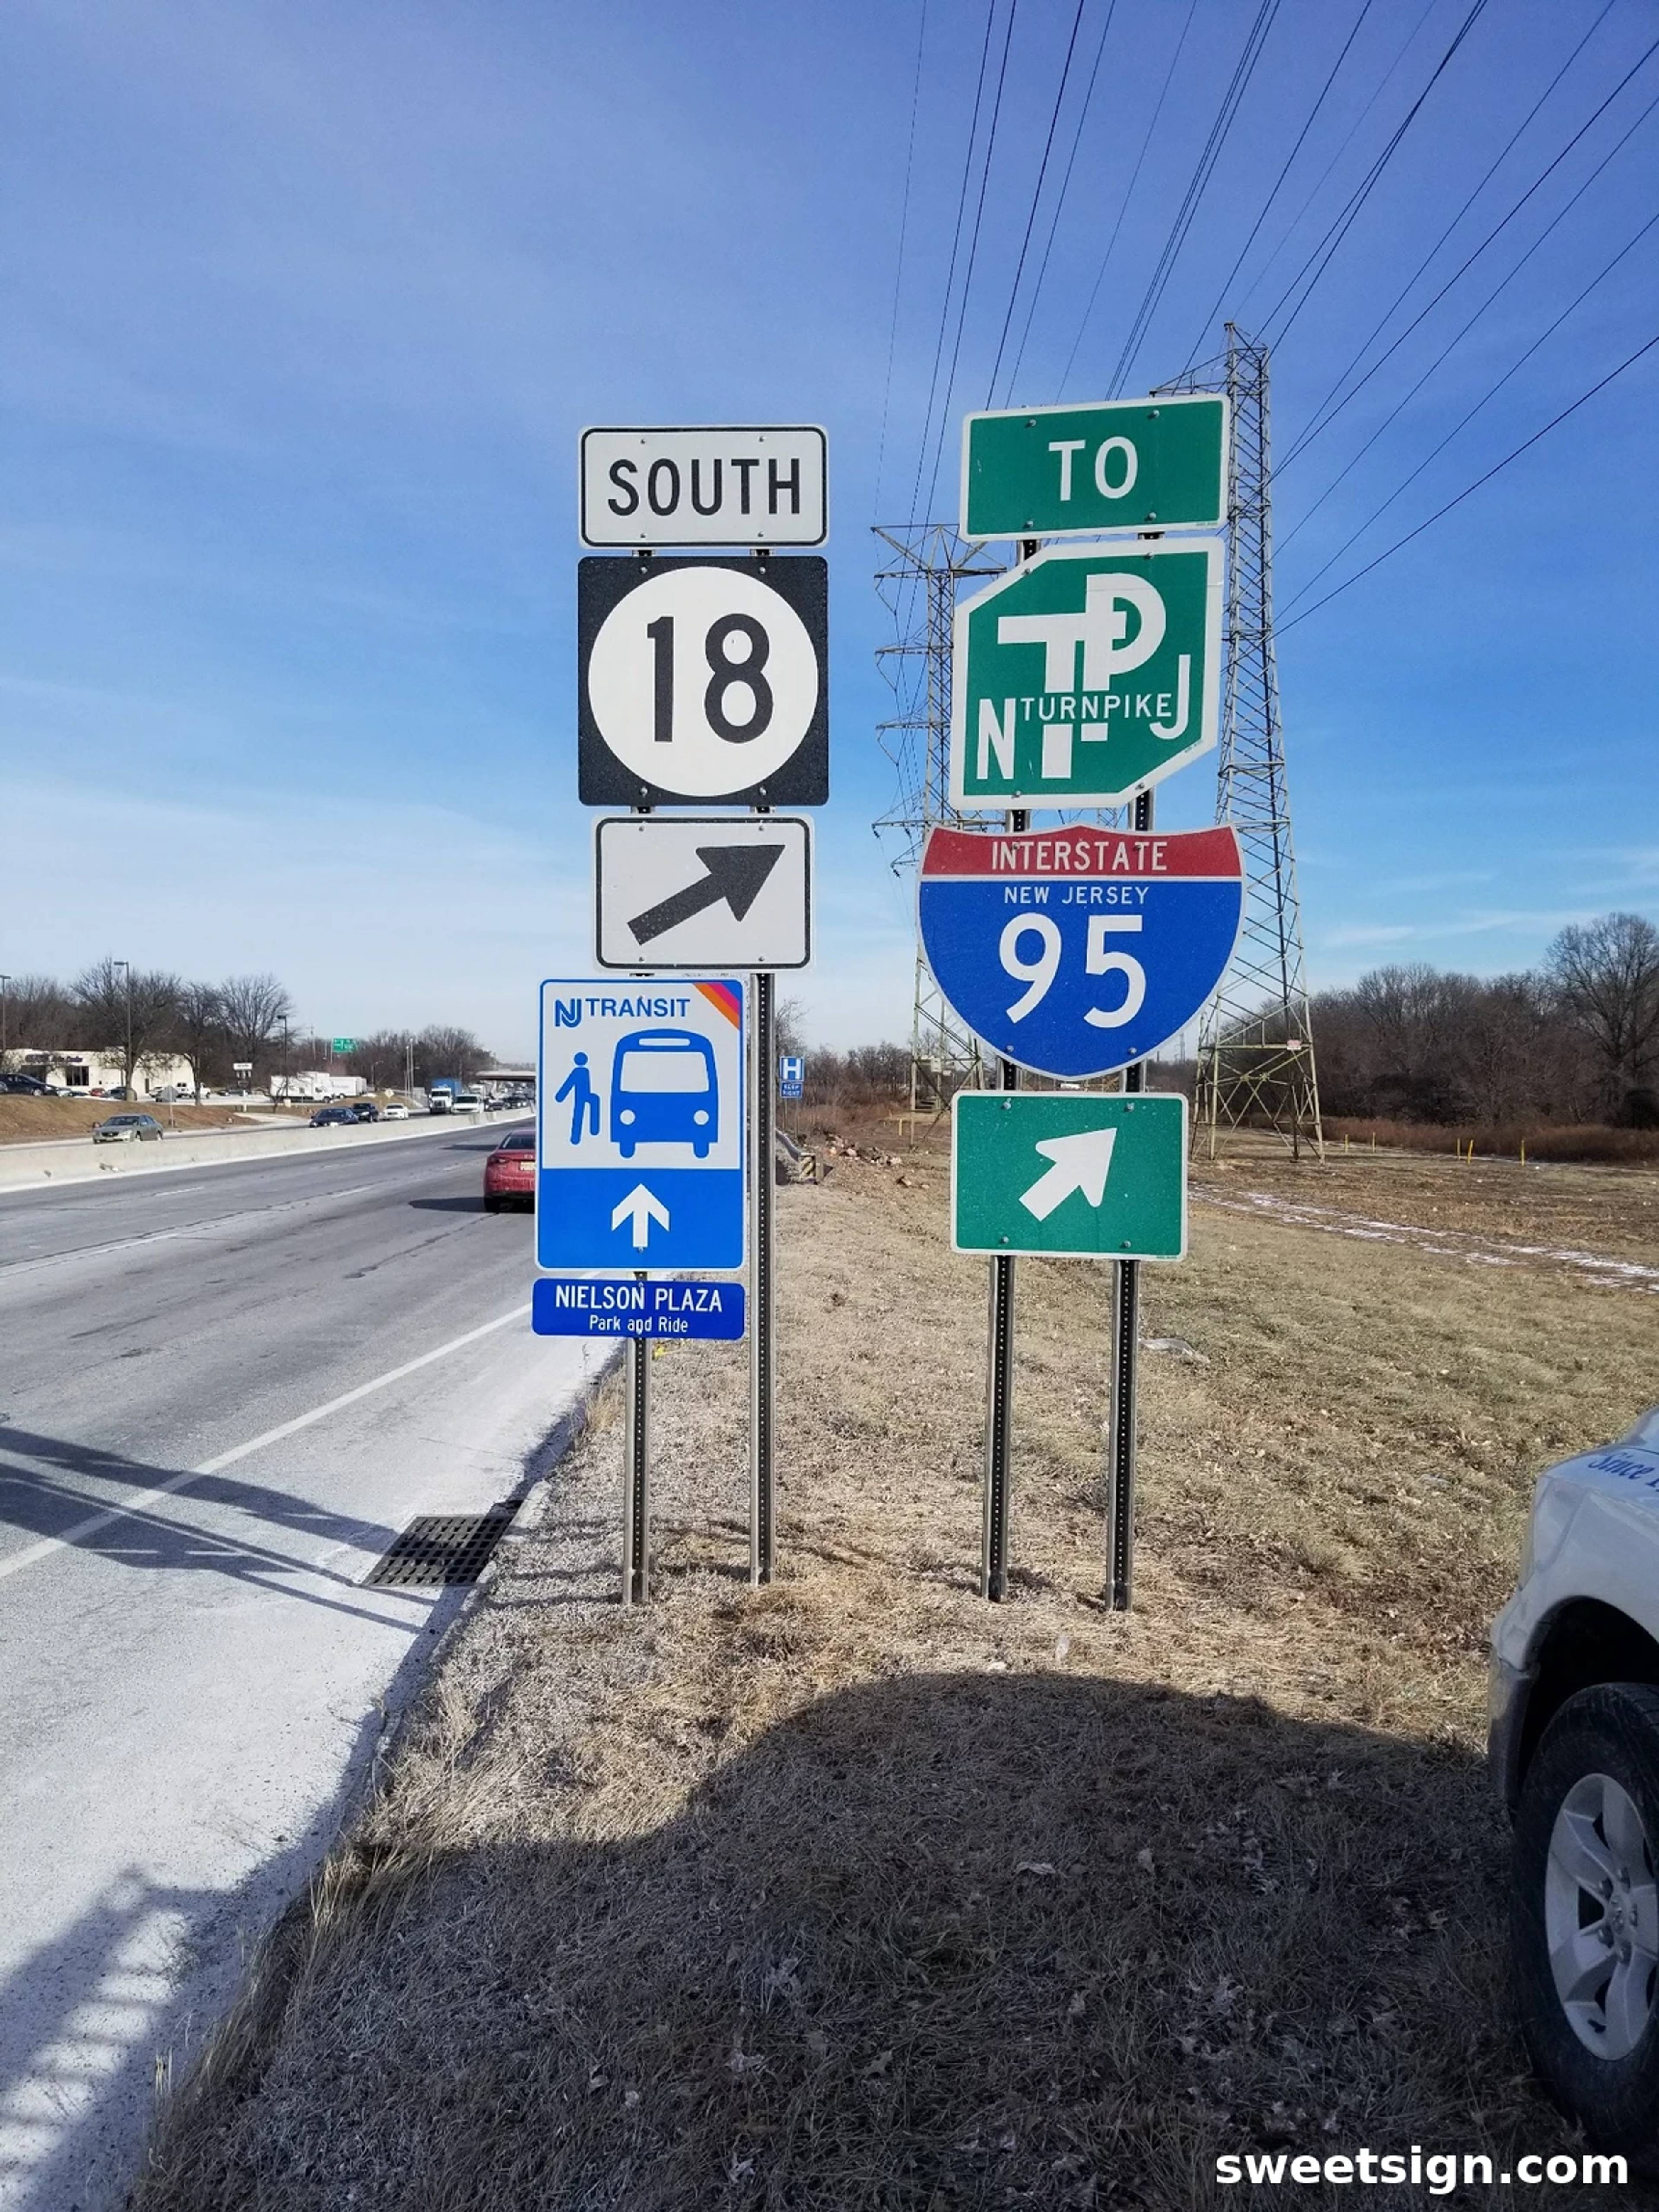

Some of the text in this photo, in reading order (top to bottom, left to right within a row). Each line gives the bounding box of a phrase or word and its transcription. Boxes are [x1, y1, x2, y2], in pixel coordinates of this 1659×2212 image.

[1048, 436, 1138, 501] TO
[608, 458, 800, 516] SOUTH
[647, 613, 773, 743] 18
[1020, 693, 1172, 721] TURNPIKE
[992, 841, 1168, 871] INTERSTATE
[1004, 886, 1149, 904] NEW JERSEY
[999, 912, 1147, 1028] 95
[585, 998, 690, 1017] TRANSIT
[782, 1058, 801, 1079] H
[556, 1286, 722, 1312] NIELSON PLAZA
[590, 1315, 688, 1334] Park and Ride
[1588, 1453, 1655, 1479] Since
